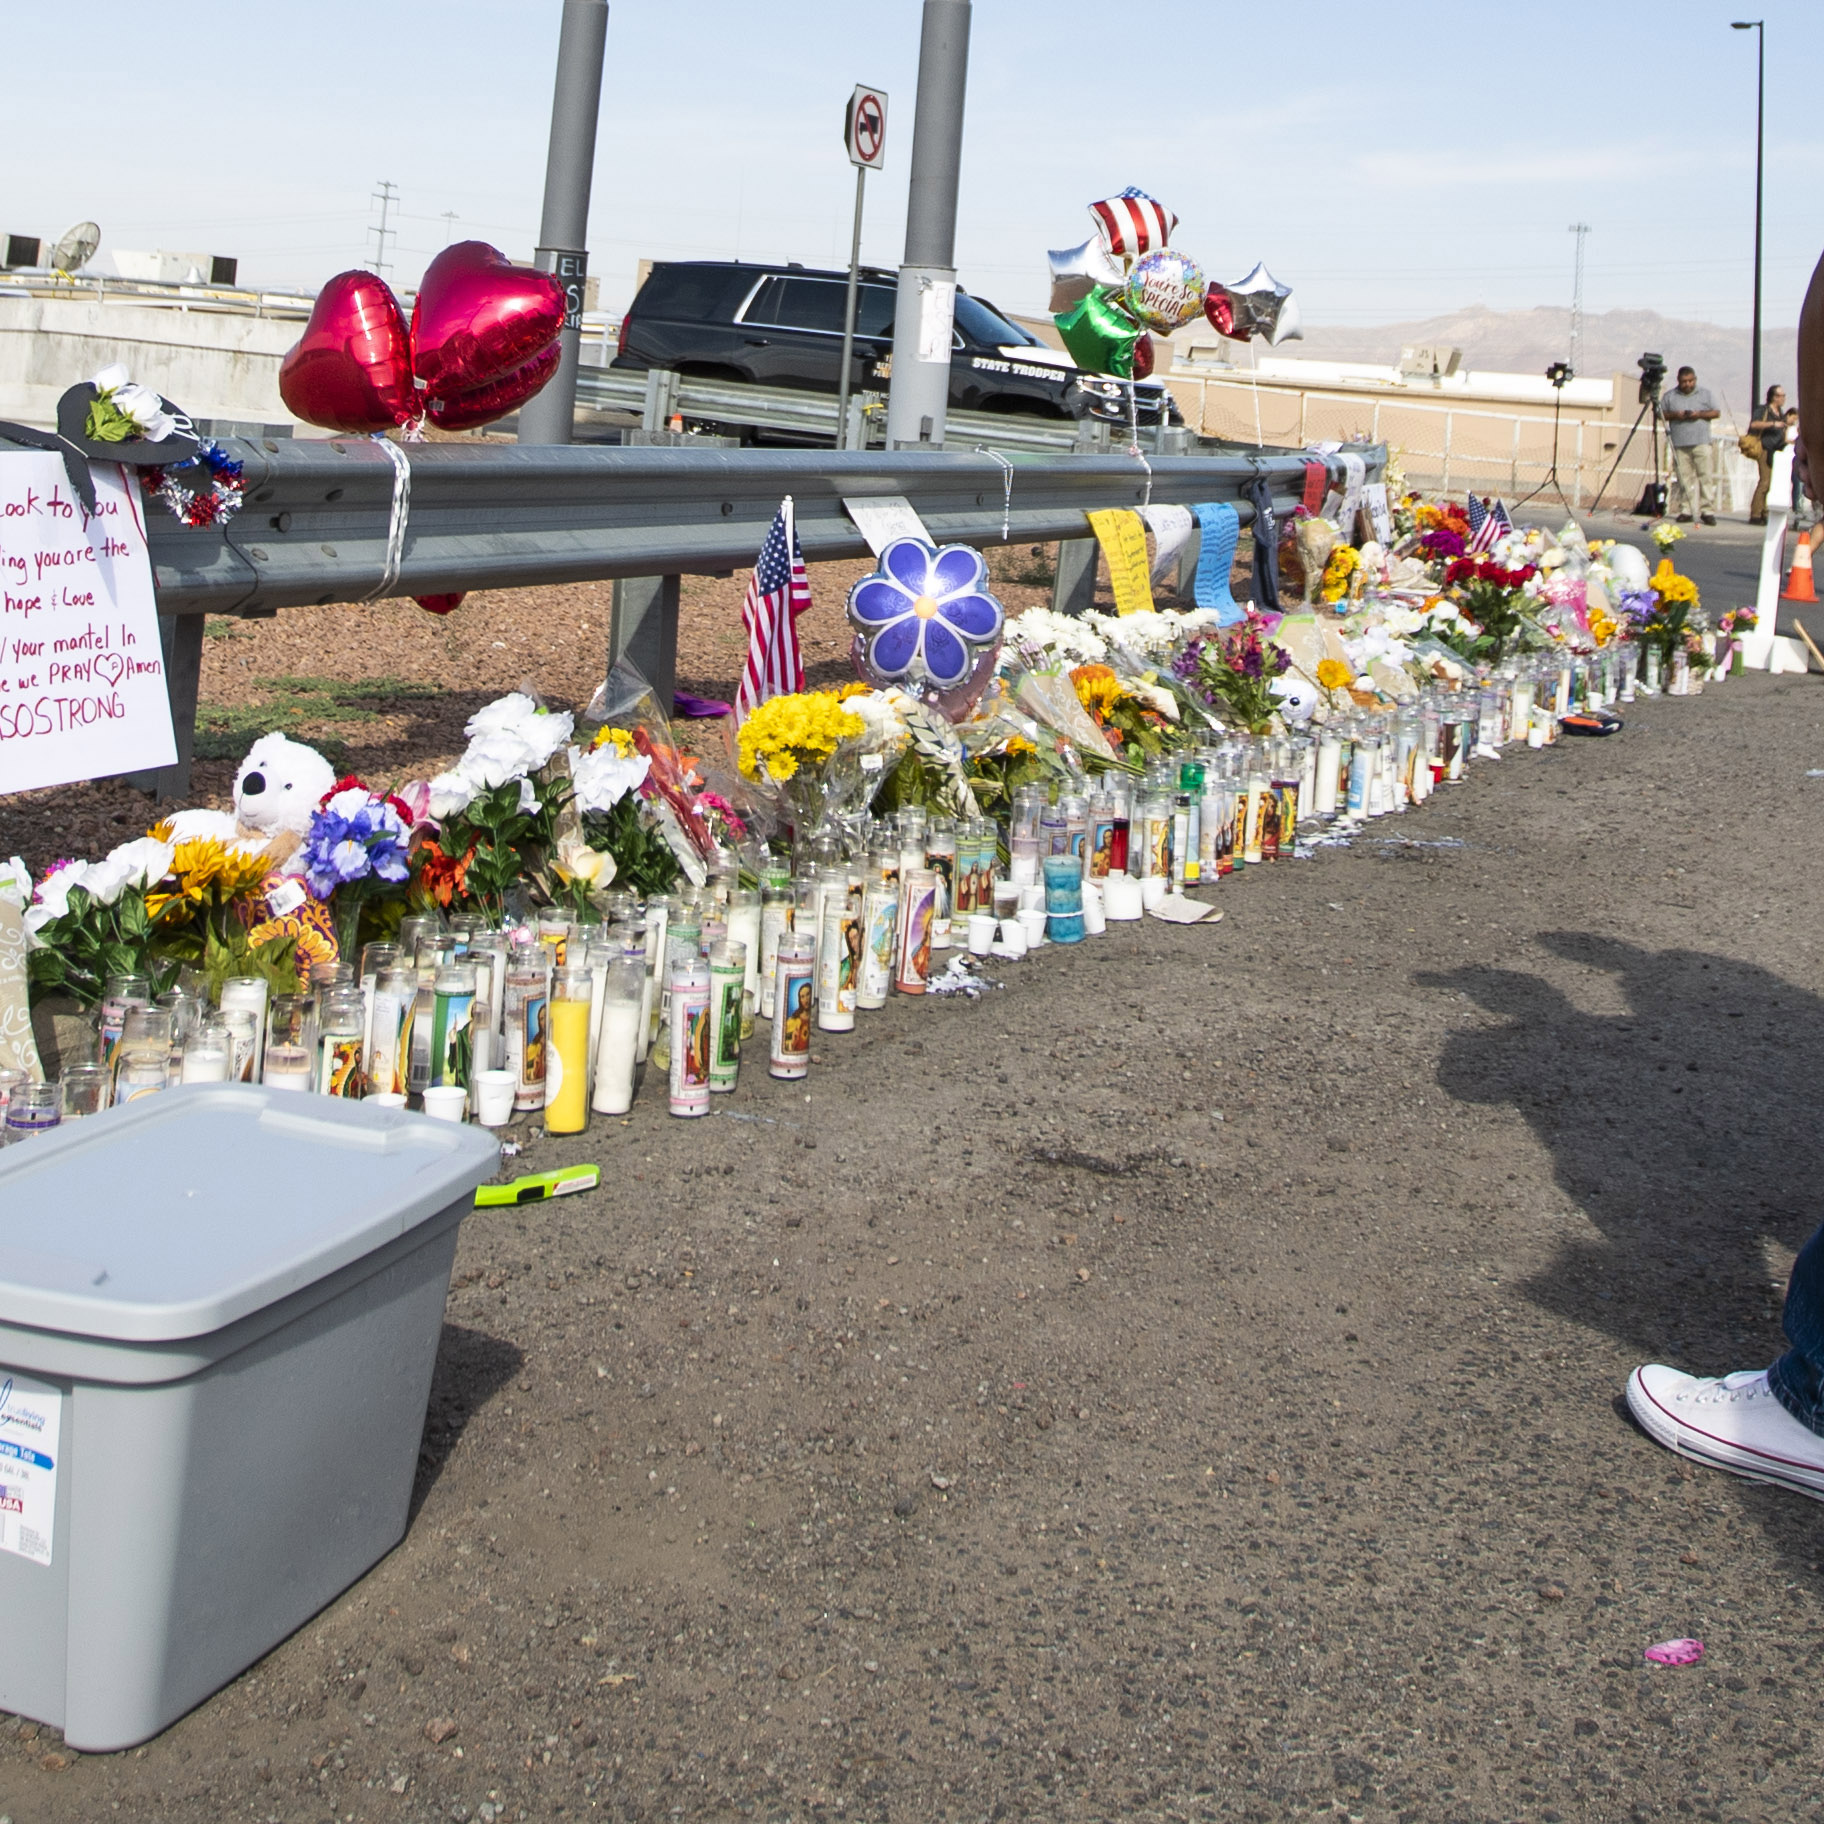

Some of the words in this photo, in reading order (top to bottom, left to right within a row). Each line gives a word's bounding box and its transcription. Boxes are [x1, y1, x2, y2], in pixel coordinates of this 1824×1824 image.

[1142, 270, 1177, 295] You're
[1139, 288, 1185, 317] SPECIAL
[972, 357, 1011, 374] STATE
[1011, 363, 1066, 383] TROOPER
[47, 485, 72, 518] to
[34, 552, 60, 581] you
[64, 547, 96, 565] are
[100, 537, 129, 557] the
[4, 591, 42, 619] hope
[63, 587, 94, 606] Love
[12, 639, 45, 664] your
[54, 623, 108, 653] mantel
[18, 674, 39, 689] we
[127, 656, 160, 680] Amen
[19, 1446, 36, 1463] Tote
